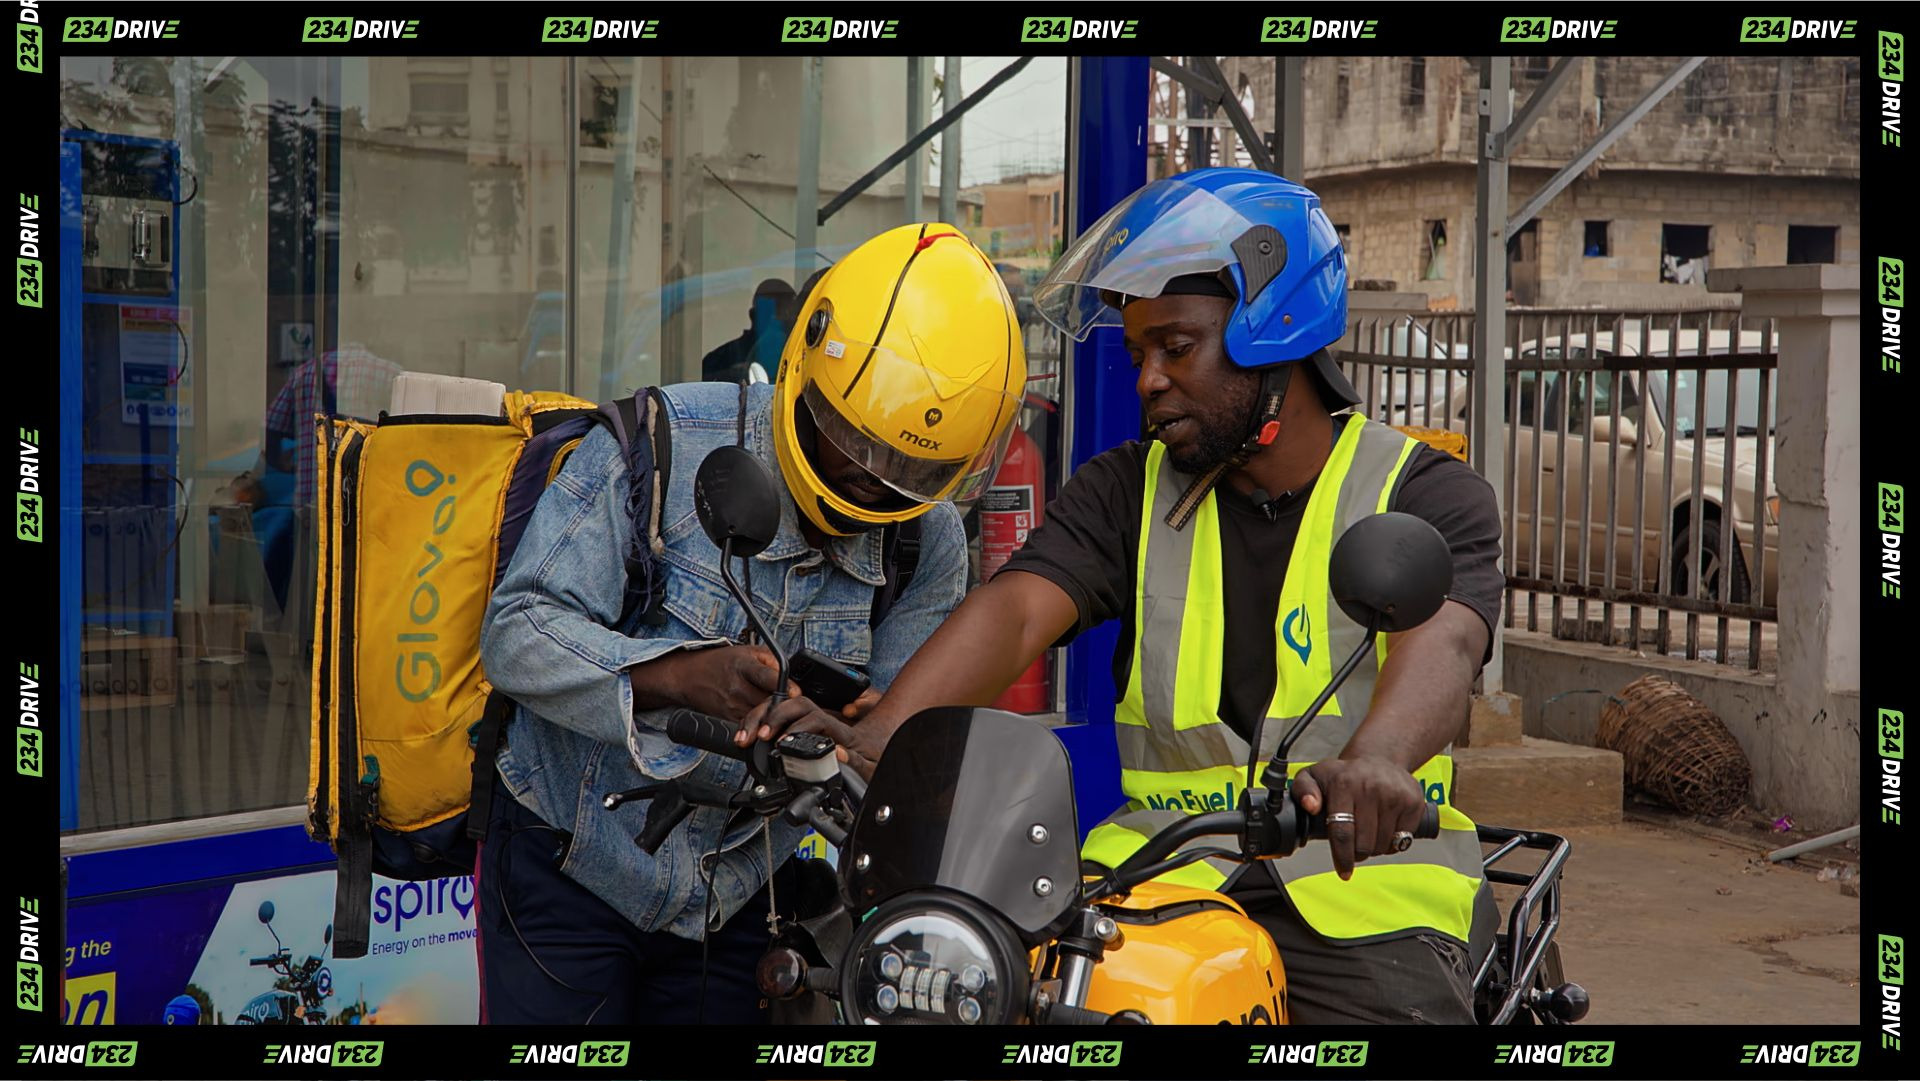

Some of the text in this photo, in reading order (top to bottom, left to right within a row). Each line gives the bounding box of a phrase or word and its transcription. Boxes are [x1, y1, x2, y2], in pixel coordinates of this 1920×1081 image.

[899, 430, 942, 451] max
[1147, 782, 1235, 812] No Fuel
[81, 940, 111, 958] the
[372, 940, 409, 955] Energy
[412, 937, 426, 948] on
[429, 933, 446, 945] the
